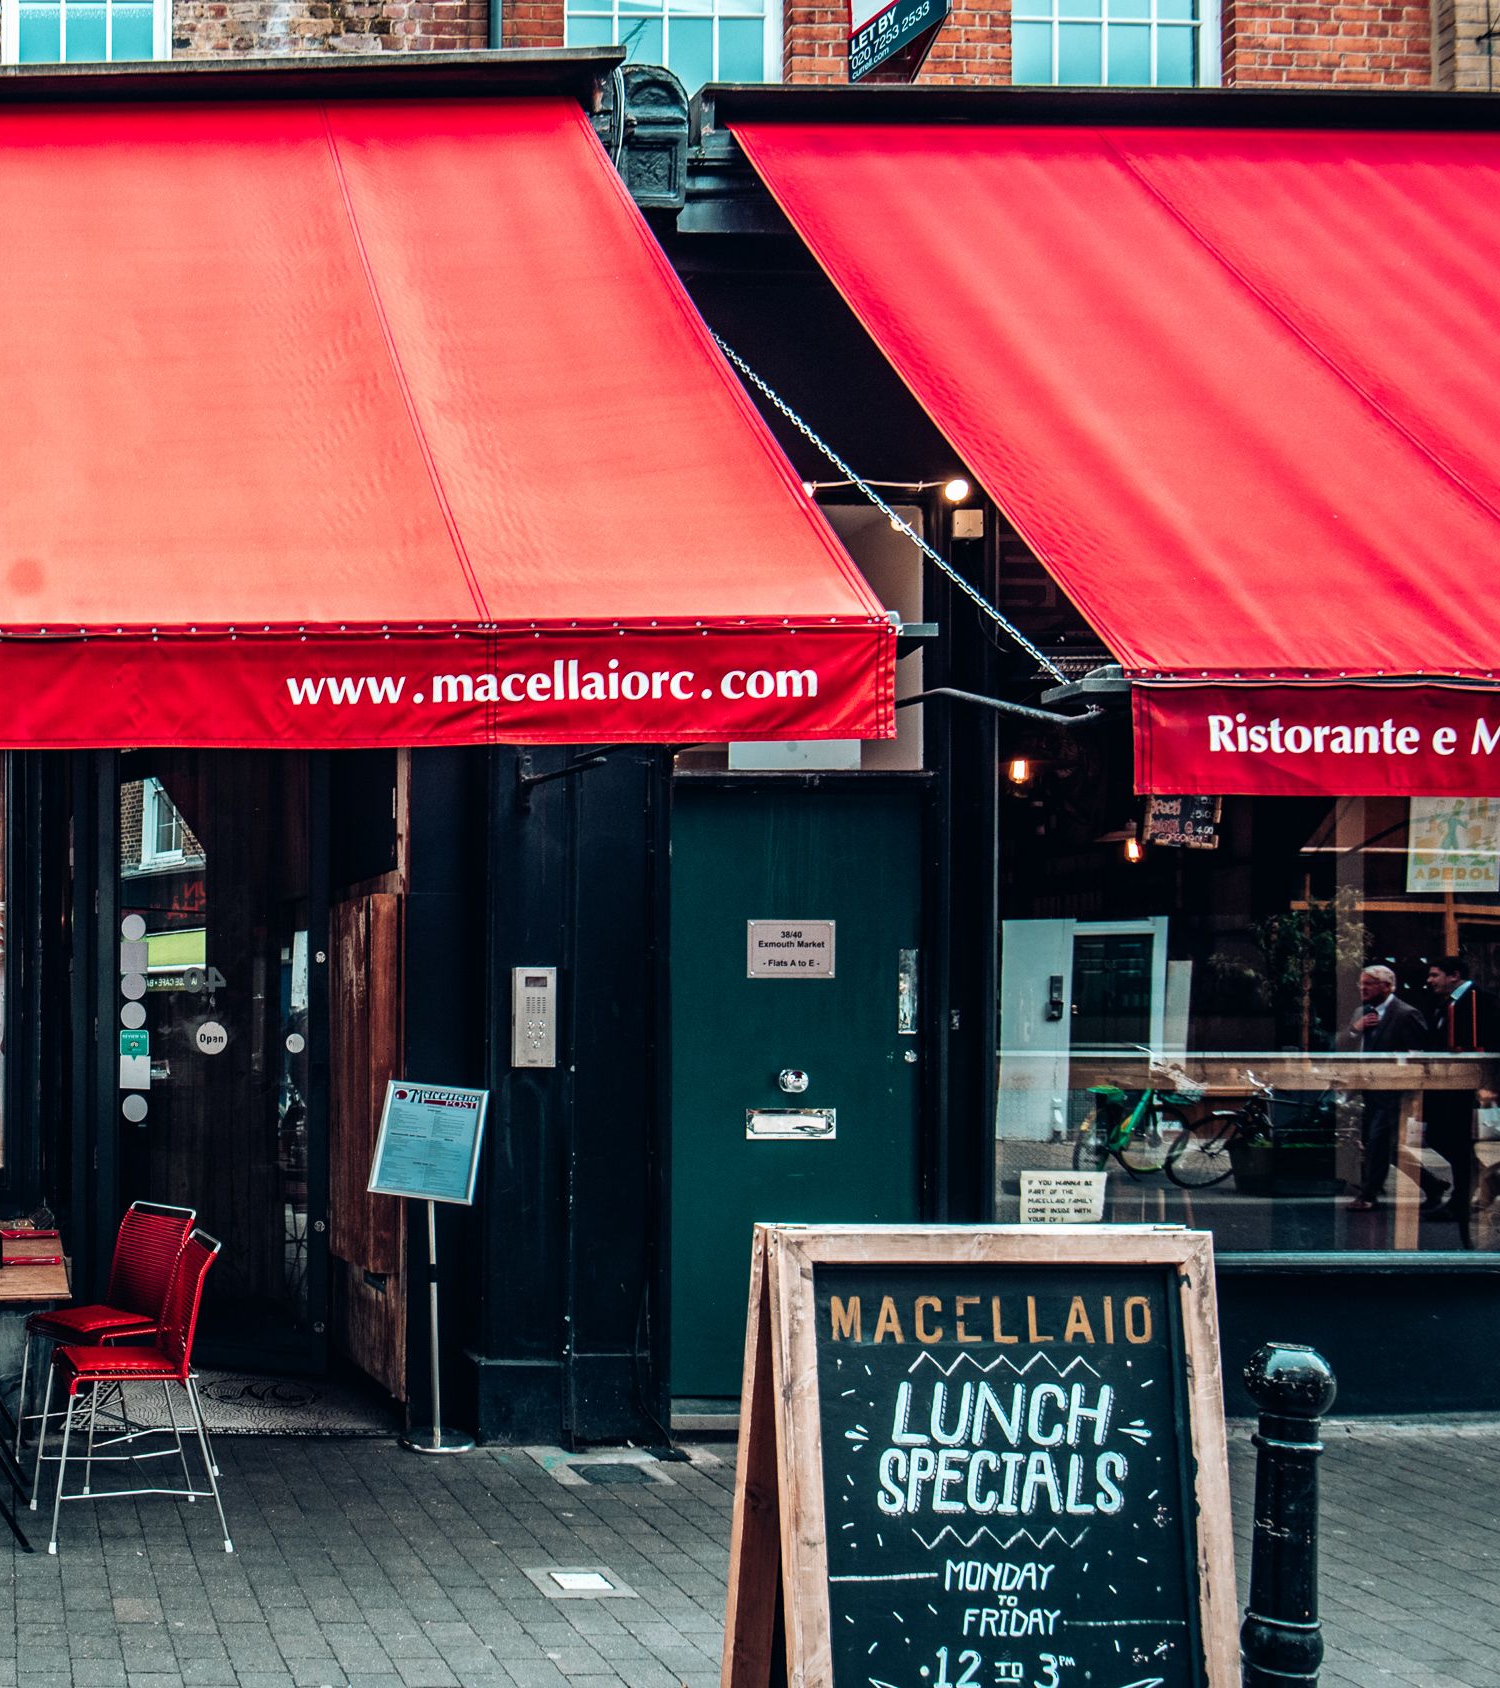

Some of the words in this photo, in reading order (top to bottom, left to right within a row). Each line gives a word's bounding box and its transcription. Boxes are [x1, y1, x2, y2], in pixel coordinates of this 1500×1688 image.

[851, 23, 877, 54] LET
[878, 6, 897, 36] BY
[851, 46, 871, 70] 020
[873, 25, 900, 54] 7253
[901, 1, 930, 33] 2533
[852, 47, 890, 80] currell.com
[287, 659, 818, 705] www.macellaiorc.com
[1207, 712, 1420, 755] Ristorante
[1432, 726, 1457, 756] e
[758, 940, 795, 949] Exmouth
[797, 940, 825, 949] Market
[780, 931, 802, 939] 38/40
[768, 959, 788, 967] Flats
[790, 959, 796, 967] A
[809, 959, 814, 967] E
[830, 1296, 1153, 1344] MACELLAIO
[892, 1381, 1116, 1447] LUNCH
[877, 1447, 1128, 1515] SPECIALS
[944, 1560, 1055, 1592] MONDAY
[997, 1595, 1018, 1607] TO
[962, 1609, 1060, 1637] FRIDAY
[934, 1647, 982, 1688] 12
[994, 1661, 1023, 1679] TO
